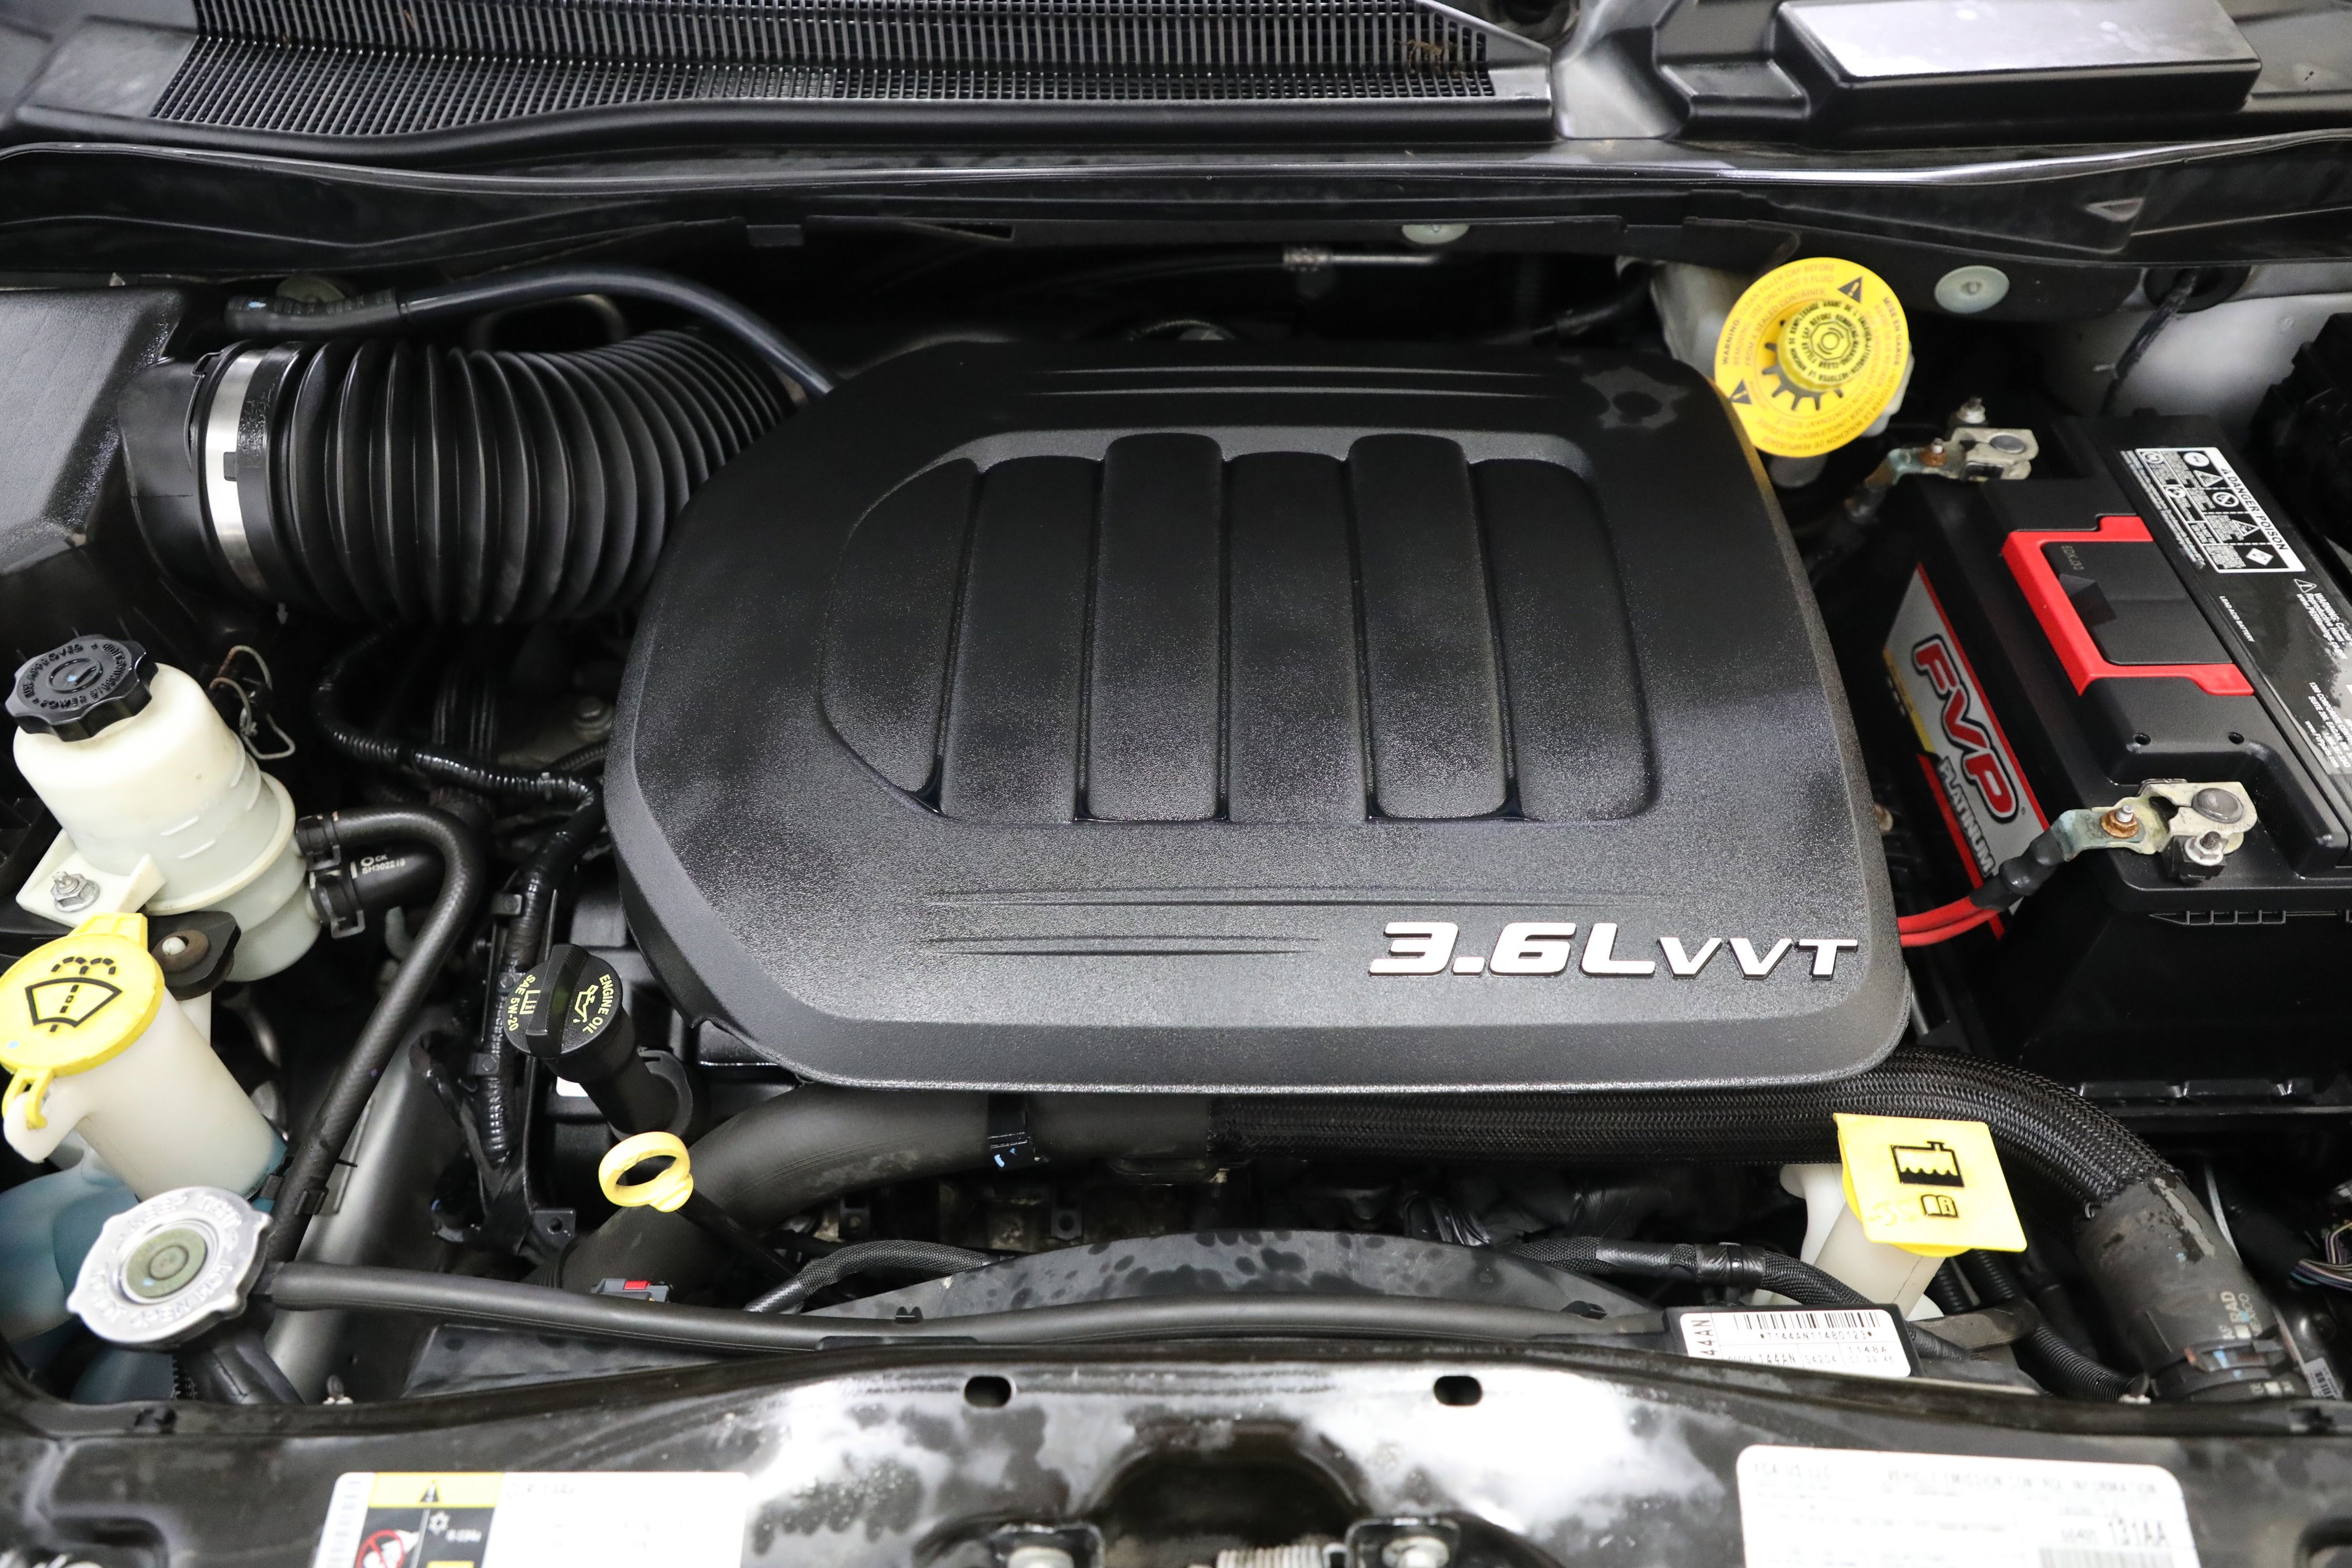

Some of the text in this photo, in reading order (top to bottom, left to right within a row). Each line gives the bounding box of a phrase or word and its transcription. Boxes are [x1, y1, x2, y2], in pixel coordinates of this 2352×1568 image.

[2217, 595, 2257, 642] LEAD ACID BATTERY
[2302, 593, 2337, 626] Reproductive
[2328, 626, 2347, 642] Harm
[2311, 592, 2343, 622] WARNING:
[2306, 695, 2325, 711] SUITE
[2312, 693, 2345, 724] CORPORATE
[1913, 635, 2018, 822] FVP
[2300, 720, 2345, 768] www.FVPparts.com
[1938, 756, 1996, 878] PLATINUM
[1368, 921, 1859, 981] 3.6L VVT
[507, 974, 536, 1032] SAE 5W-20
[582, 973, 614, 1034] ENGINE OIL
[2220, 1291, 2241, 1324] RAD
